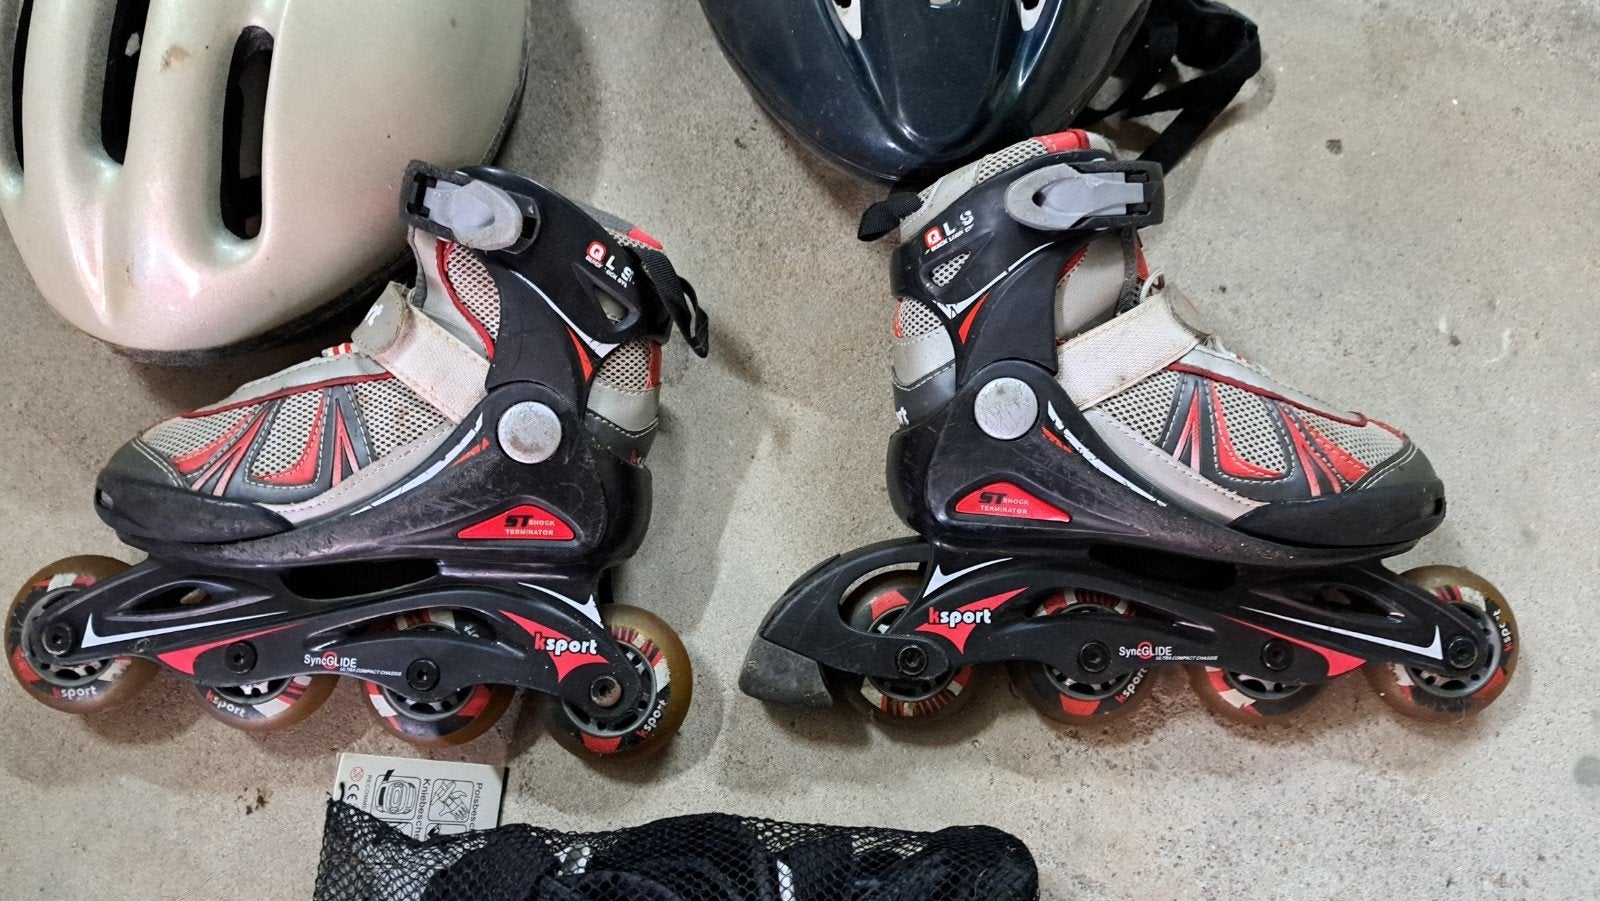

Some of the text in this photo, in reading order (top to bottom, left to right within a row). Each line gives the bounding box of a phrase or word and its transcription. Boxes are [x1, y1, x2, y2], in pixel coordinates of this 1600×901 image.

[980, 505, 1028, 514] TERMINATOR
[1003, 497, 1030, 506] SHOCK
[929, 606, 992, 628] ksport
[534, 632, 598, 655] ksport
[52, 685, 98, 699] ksport
[1115, 668, 1148, 704] ksport
[206, 690, 246, 718] ksport
[469, 782, 483, 831] Polsbesc
